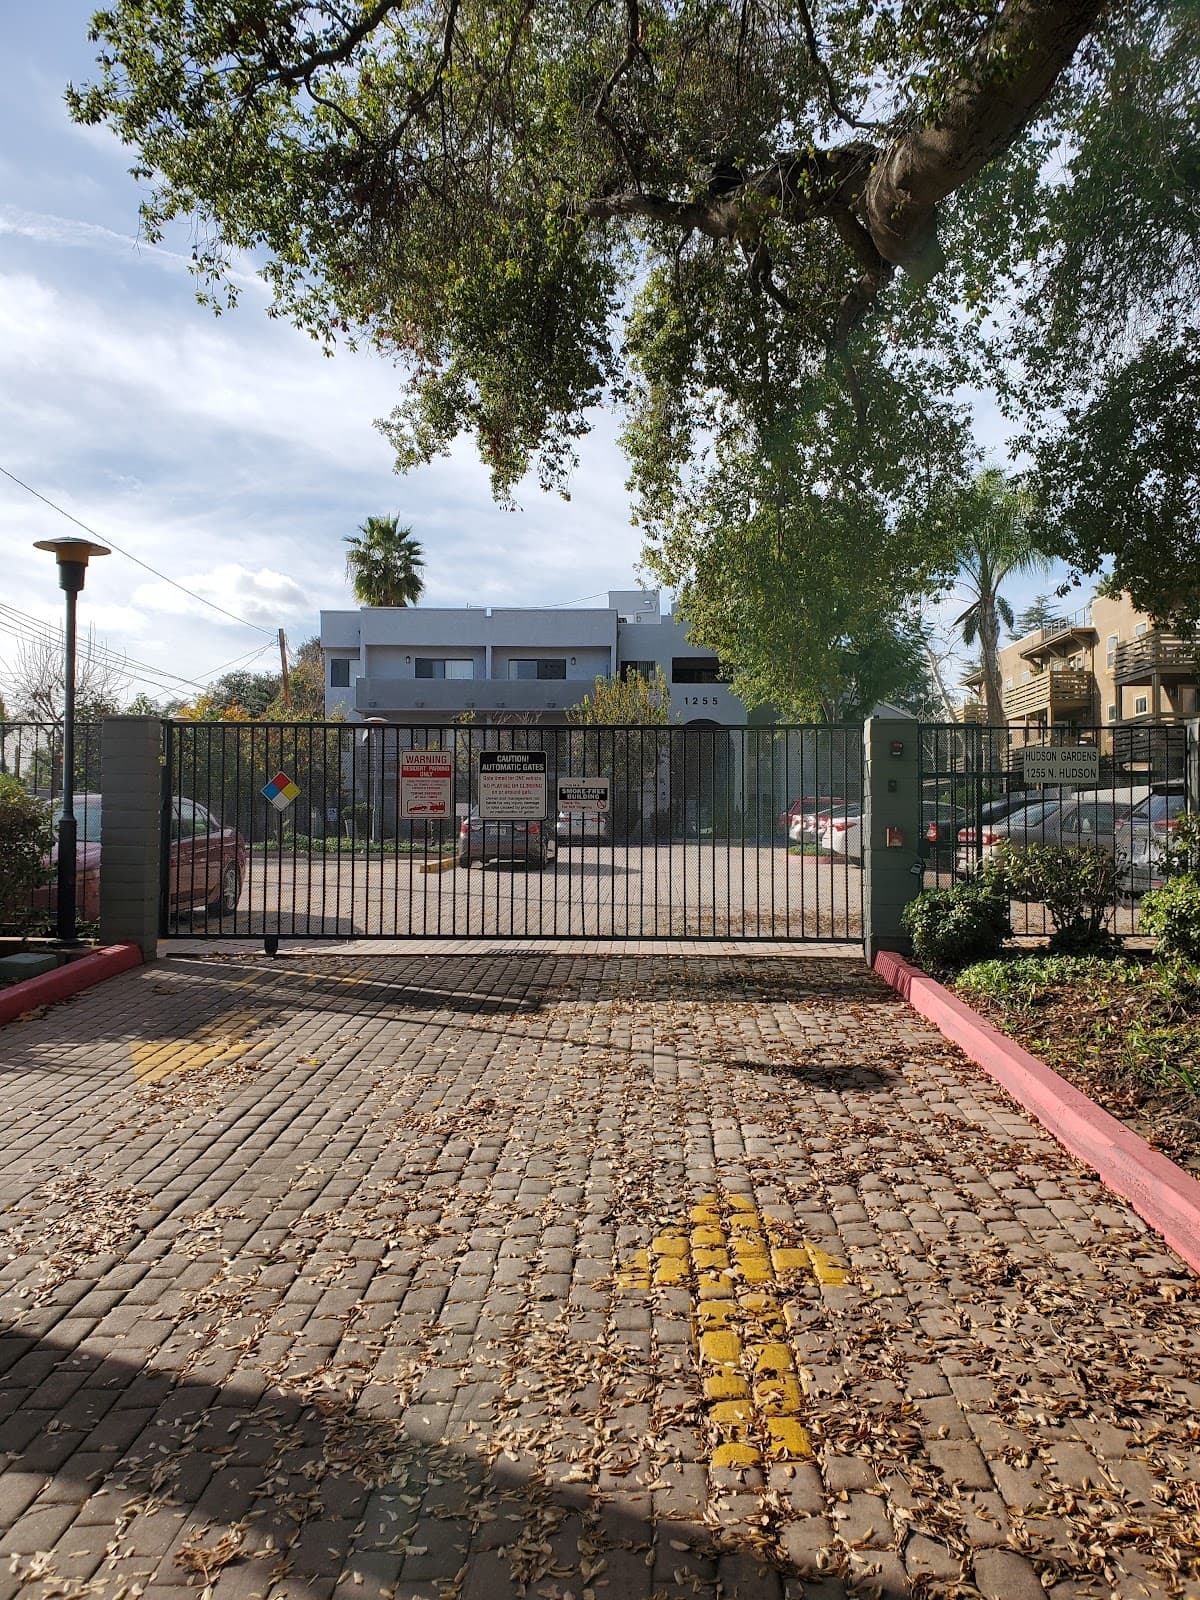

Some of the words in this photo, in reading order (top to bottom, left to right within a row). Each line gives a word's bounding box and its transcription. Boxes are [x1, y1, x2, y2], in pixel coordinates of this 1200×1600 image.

[684, 696, 718, 705] 1255
[405, 755, 447, 764] WARNING
[496, 755, 529, 763] CAUTION!
[1025, 751, 1057, 762] HUDSON
[1060, 751, 1097, 762] GARDENS
[481, 763, 522, 771] AUTOMATIC
[522, 763, 544, 771] GATES
[1026, 768, 1046, 778] 1255
[1047, 768, 1057, 778] N.
[1059, 768, 1096, 778] HUDSON
